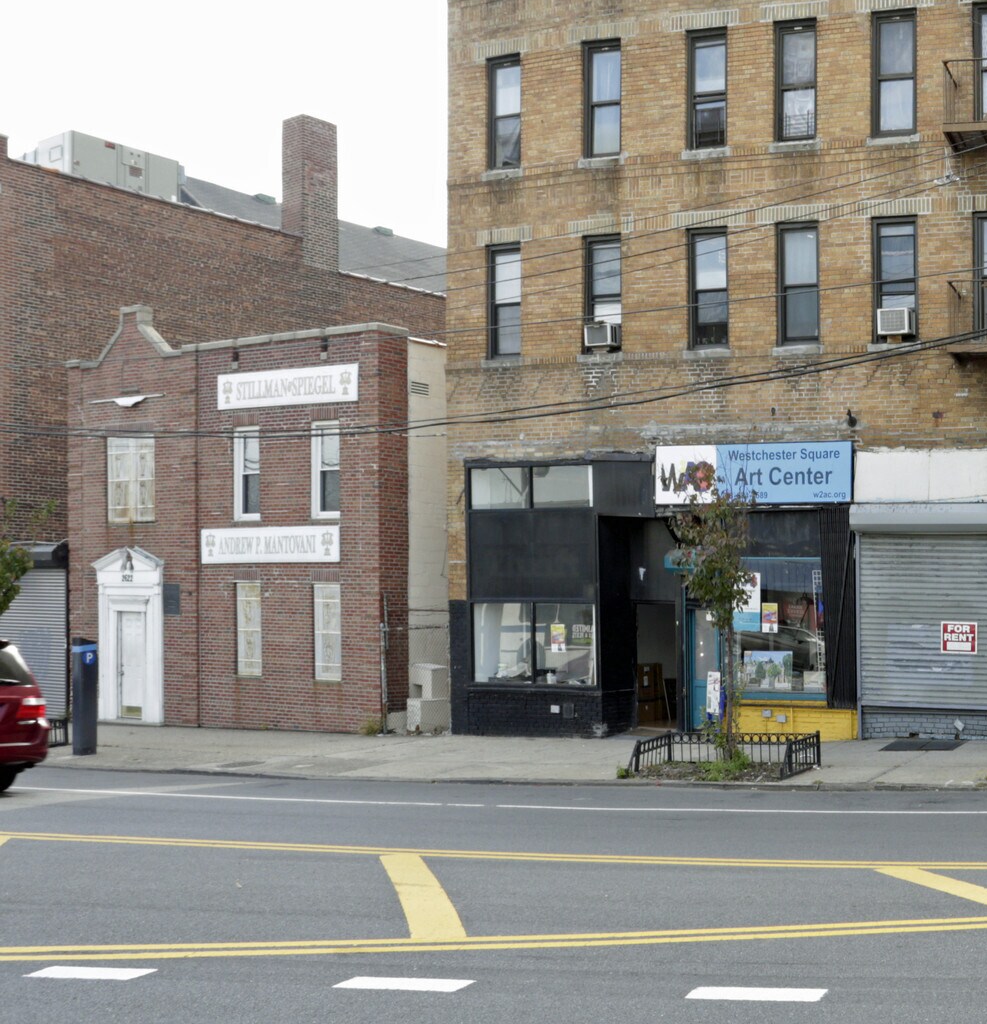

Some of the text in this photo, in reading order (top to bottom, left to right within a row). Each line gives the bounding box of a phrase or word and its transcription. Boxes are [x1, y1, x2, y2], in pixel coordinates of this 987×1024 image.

[728, 448, 840, 462] Westchester Square
[734, 466, 833, 486] Art Center
[813, 491, 847, 500] w2ac.org
[218, 536, 254, 555] ANDREW
[264, 535, 316, 554] MANTOVANI
[947, 624, 970, 633] FOR
[944, 633, 974, 641] RENT
[86, 652, 93, 663] P
